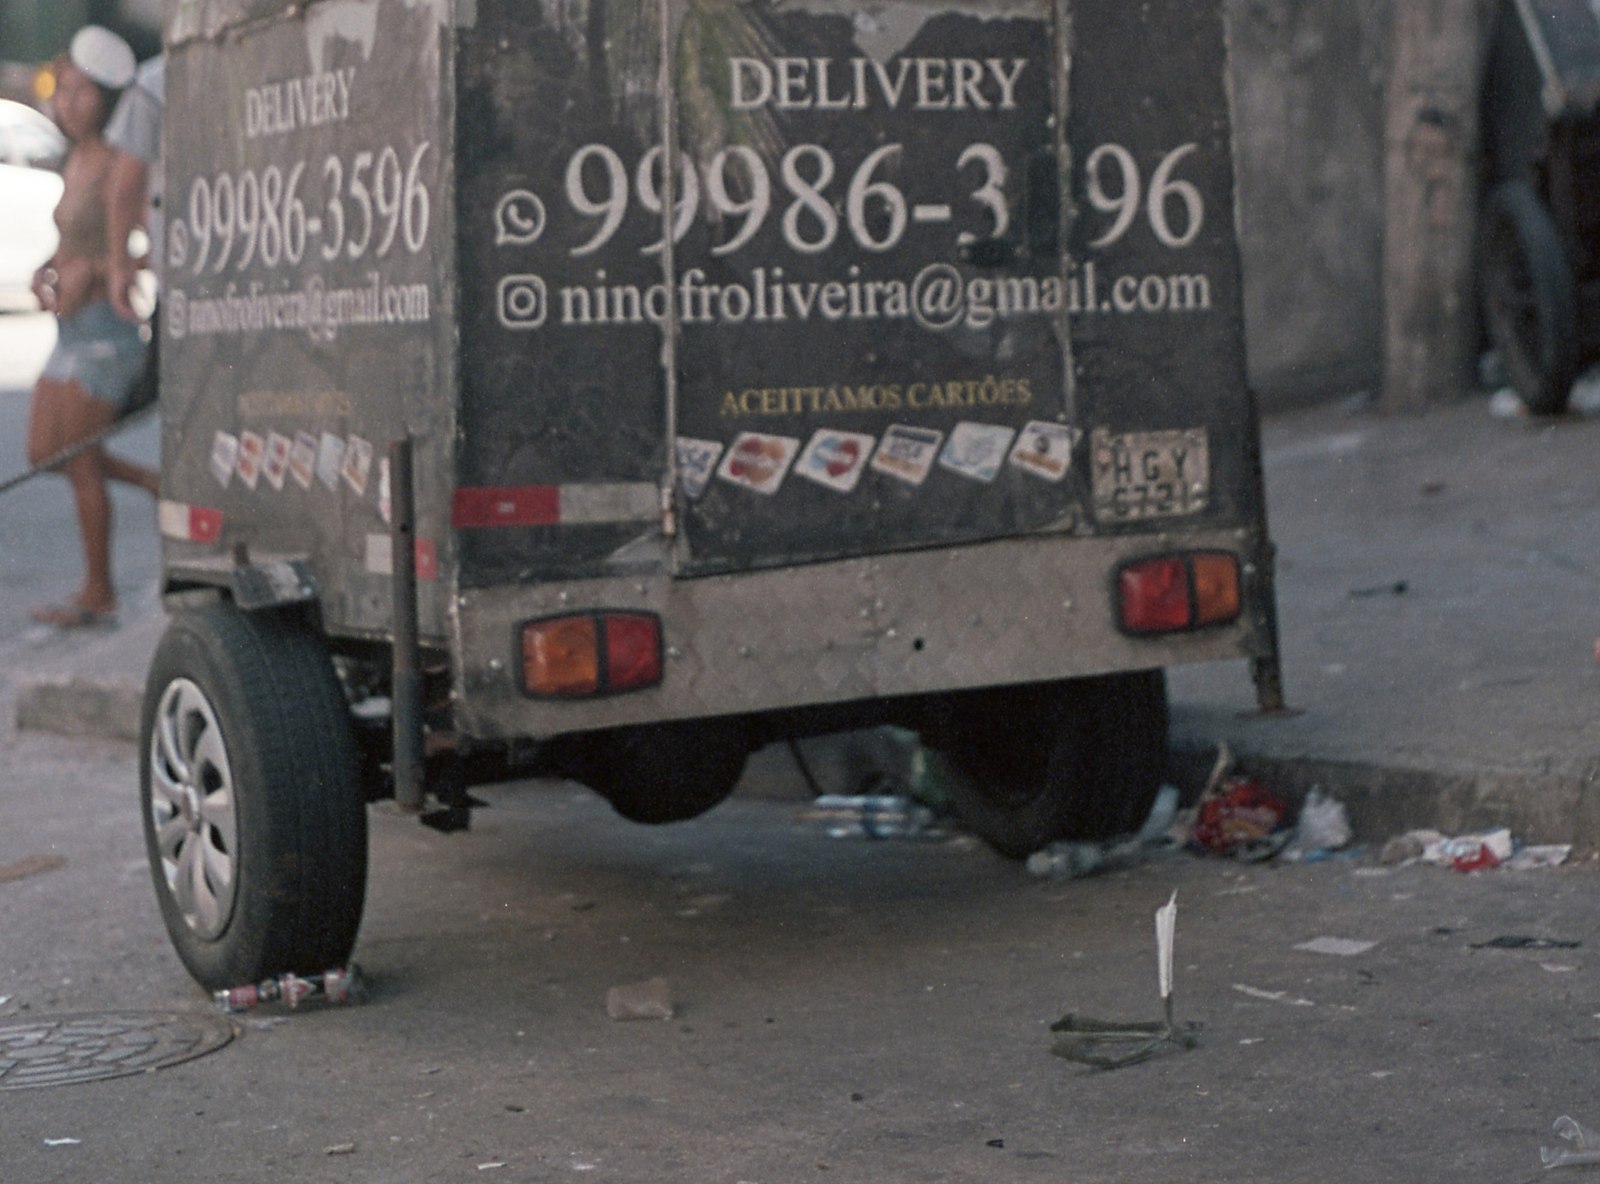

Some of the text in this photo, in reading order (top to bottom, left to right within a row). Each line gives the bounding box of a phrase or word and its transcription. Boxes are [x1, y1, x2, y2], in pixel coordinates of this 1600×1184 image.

[246, 66, 356, 137] DELIVERY
[728, 56, 1028, 110] DELIVERY
[189, 140, 431, 276] 99986-3596
[565, 142, 1205, 257] 99986-396
[720, 374, 1033, 416] ACEITTAMOS CARTÕES
[1113, 446, 1188, 482] HGY
